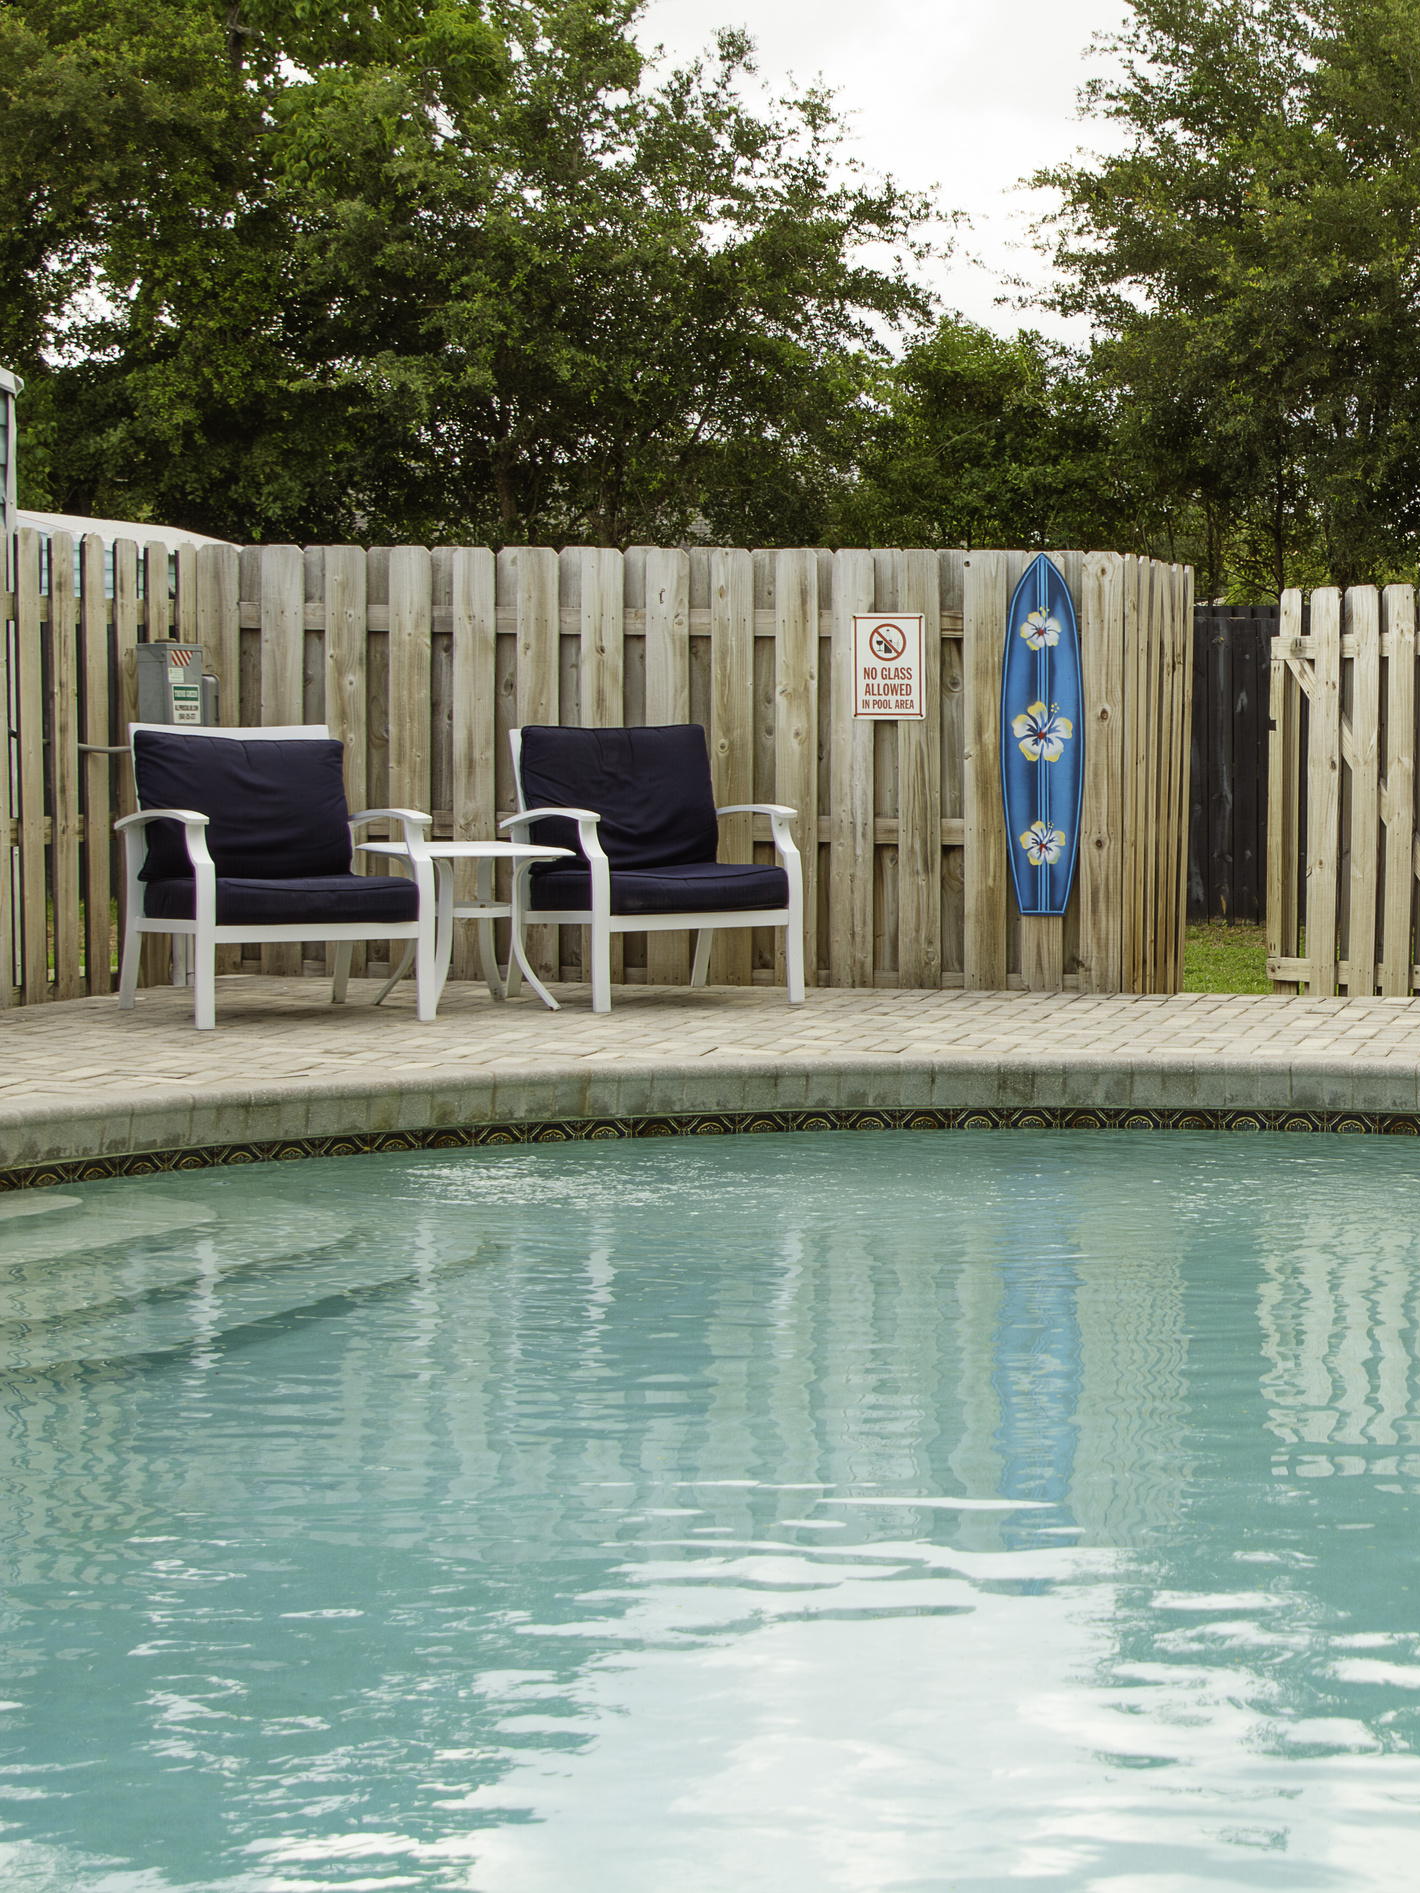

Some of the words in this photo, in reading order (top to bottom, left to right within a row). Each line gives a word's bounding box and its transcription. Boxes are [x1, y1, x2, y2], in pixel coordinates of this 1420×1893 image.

[864, 667, 877, 680] NO
[881, 667, 912, 680] GLASS
[864, 683, 912, 696] ALLOWED
[862, 699, 870, 709] IN
[872, 699, 892, 709] POOL
[894, 699, 914, 710] AREA
